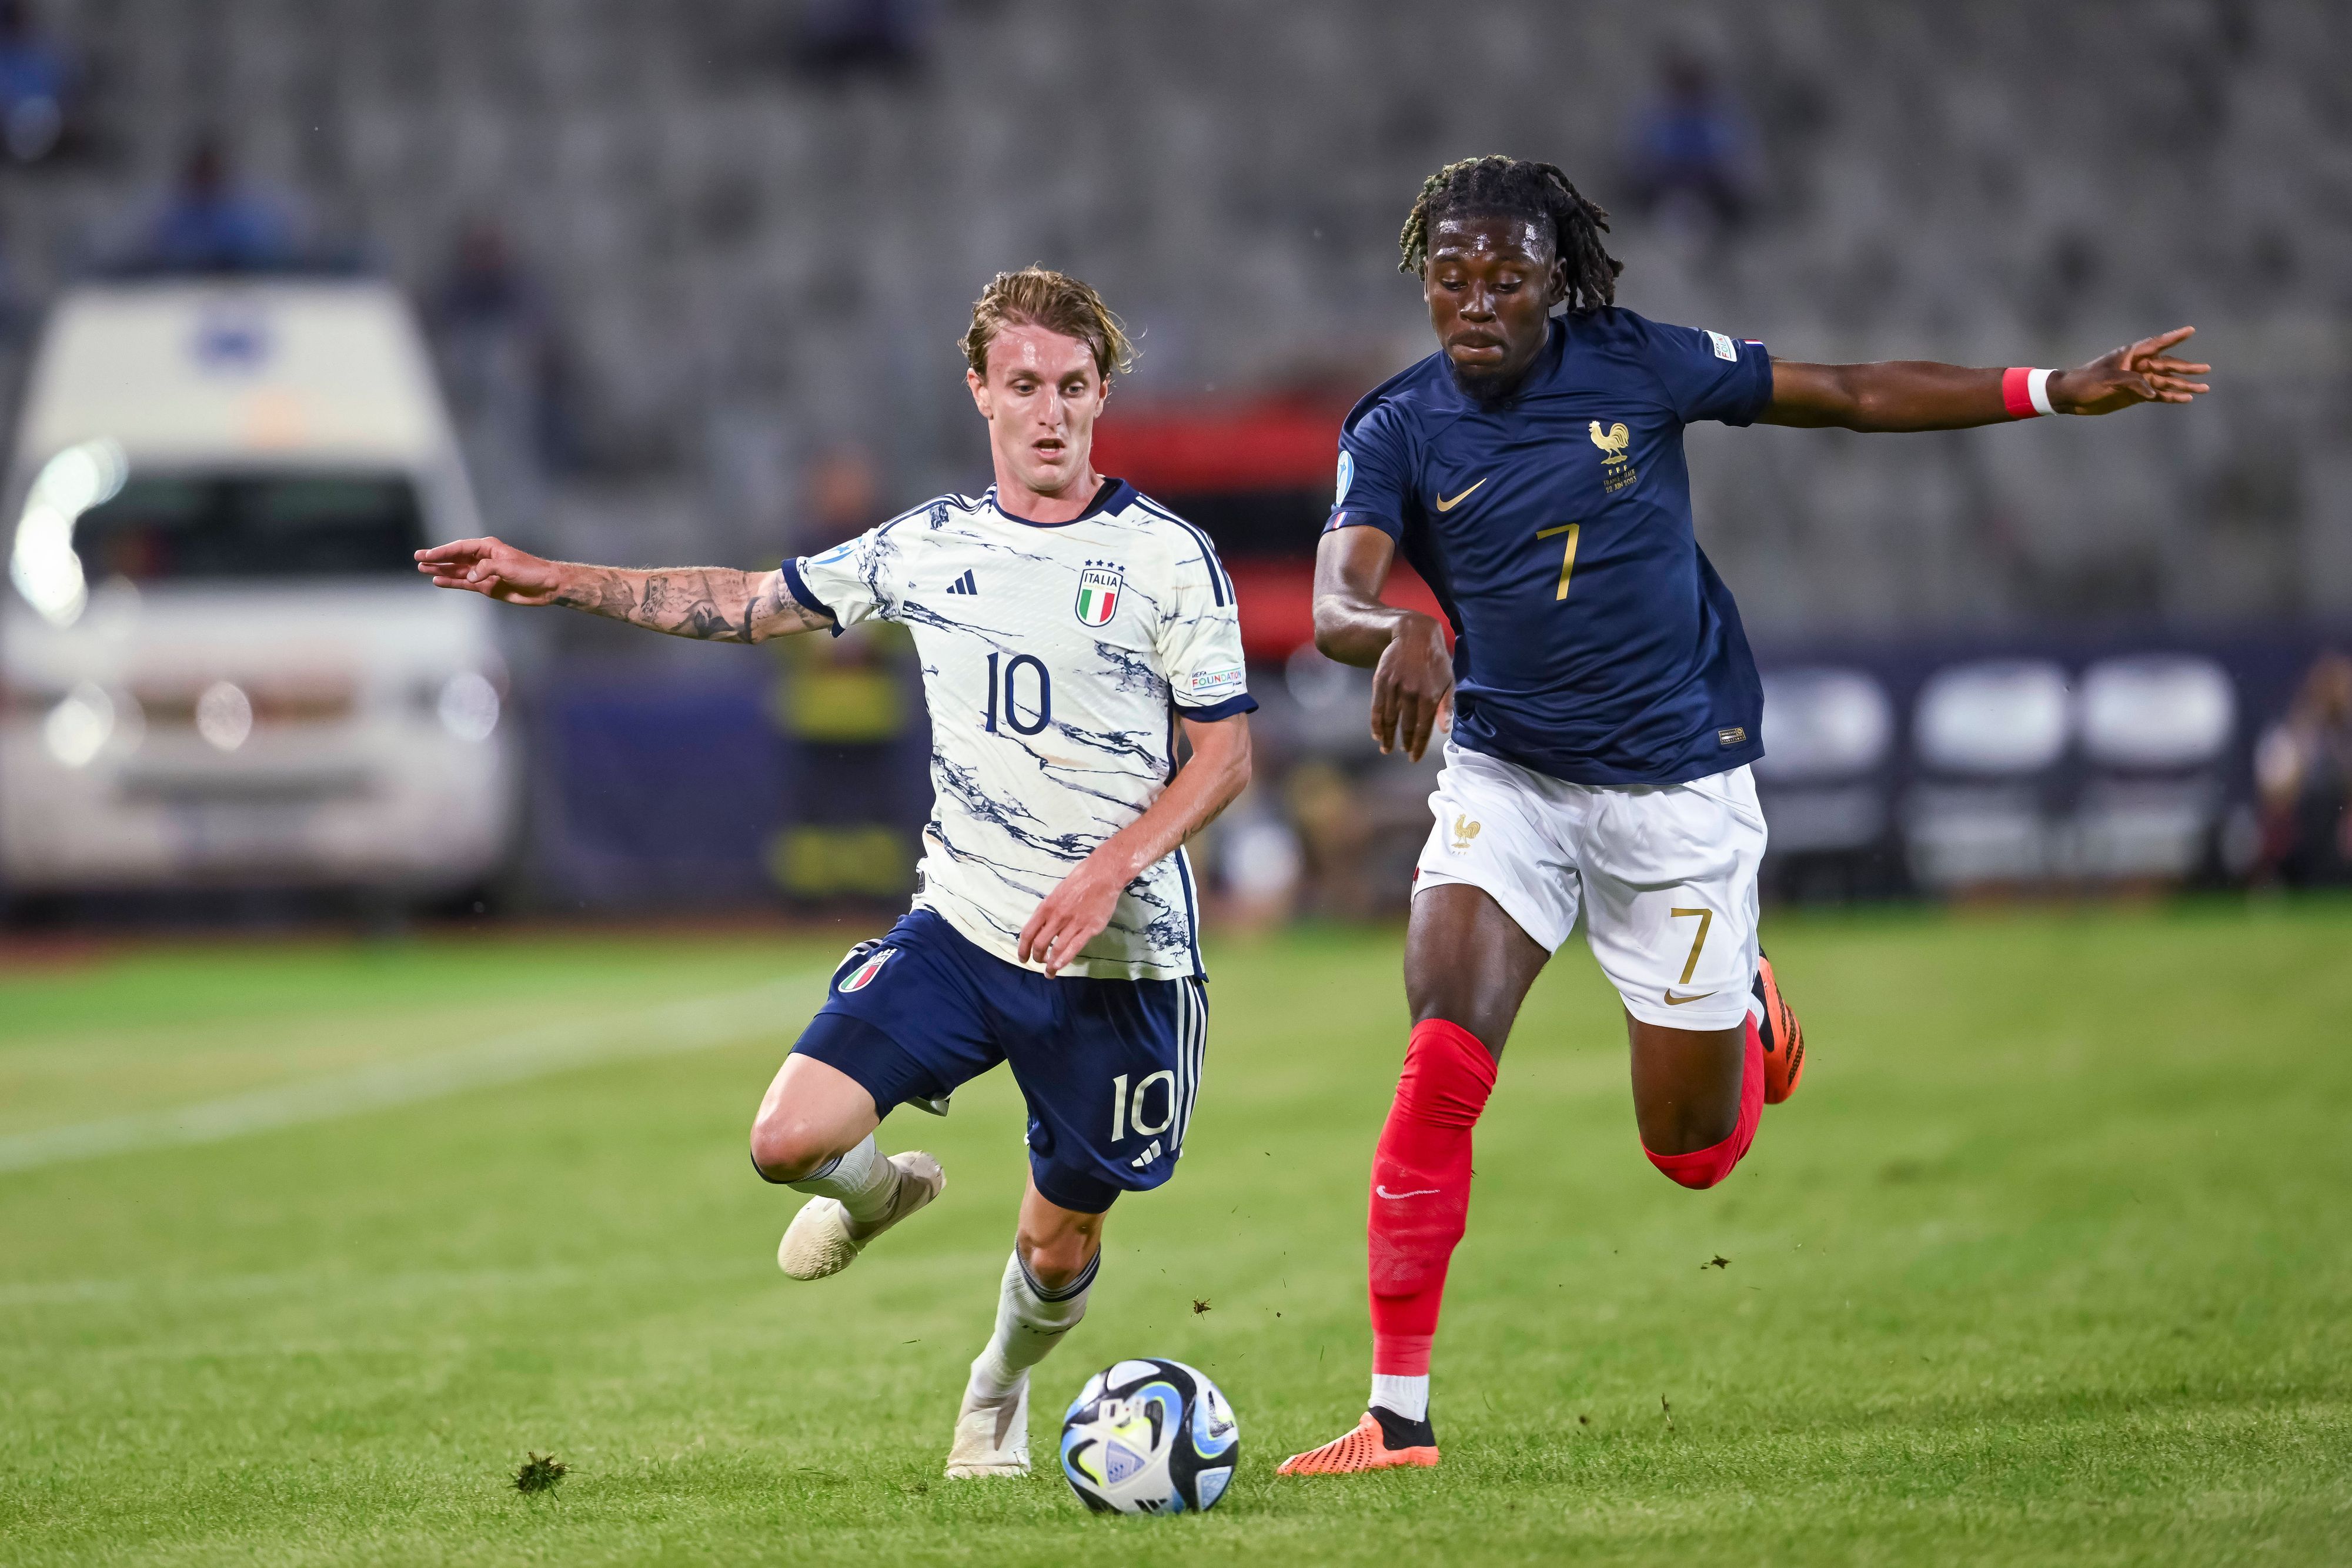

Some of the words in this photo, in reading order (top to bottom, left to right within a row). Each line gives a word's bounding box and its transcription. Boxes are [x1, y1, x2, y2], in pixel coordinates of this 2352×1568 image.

[1623, 476, 1637, 486] 2023
[1084, 573, 1117, 587] ITALIA
[1536, 523, 1580, 601] 7
[985, 651, 1051, 735] 10
[1192, 670, 1241, 687] FOUNDATION
[1670, 907, 1713, 984] 7
[1111, 1070, 1175, 1142] 10
